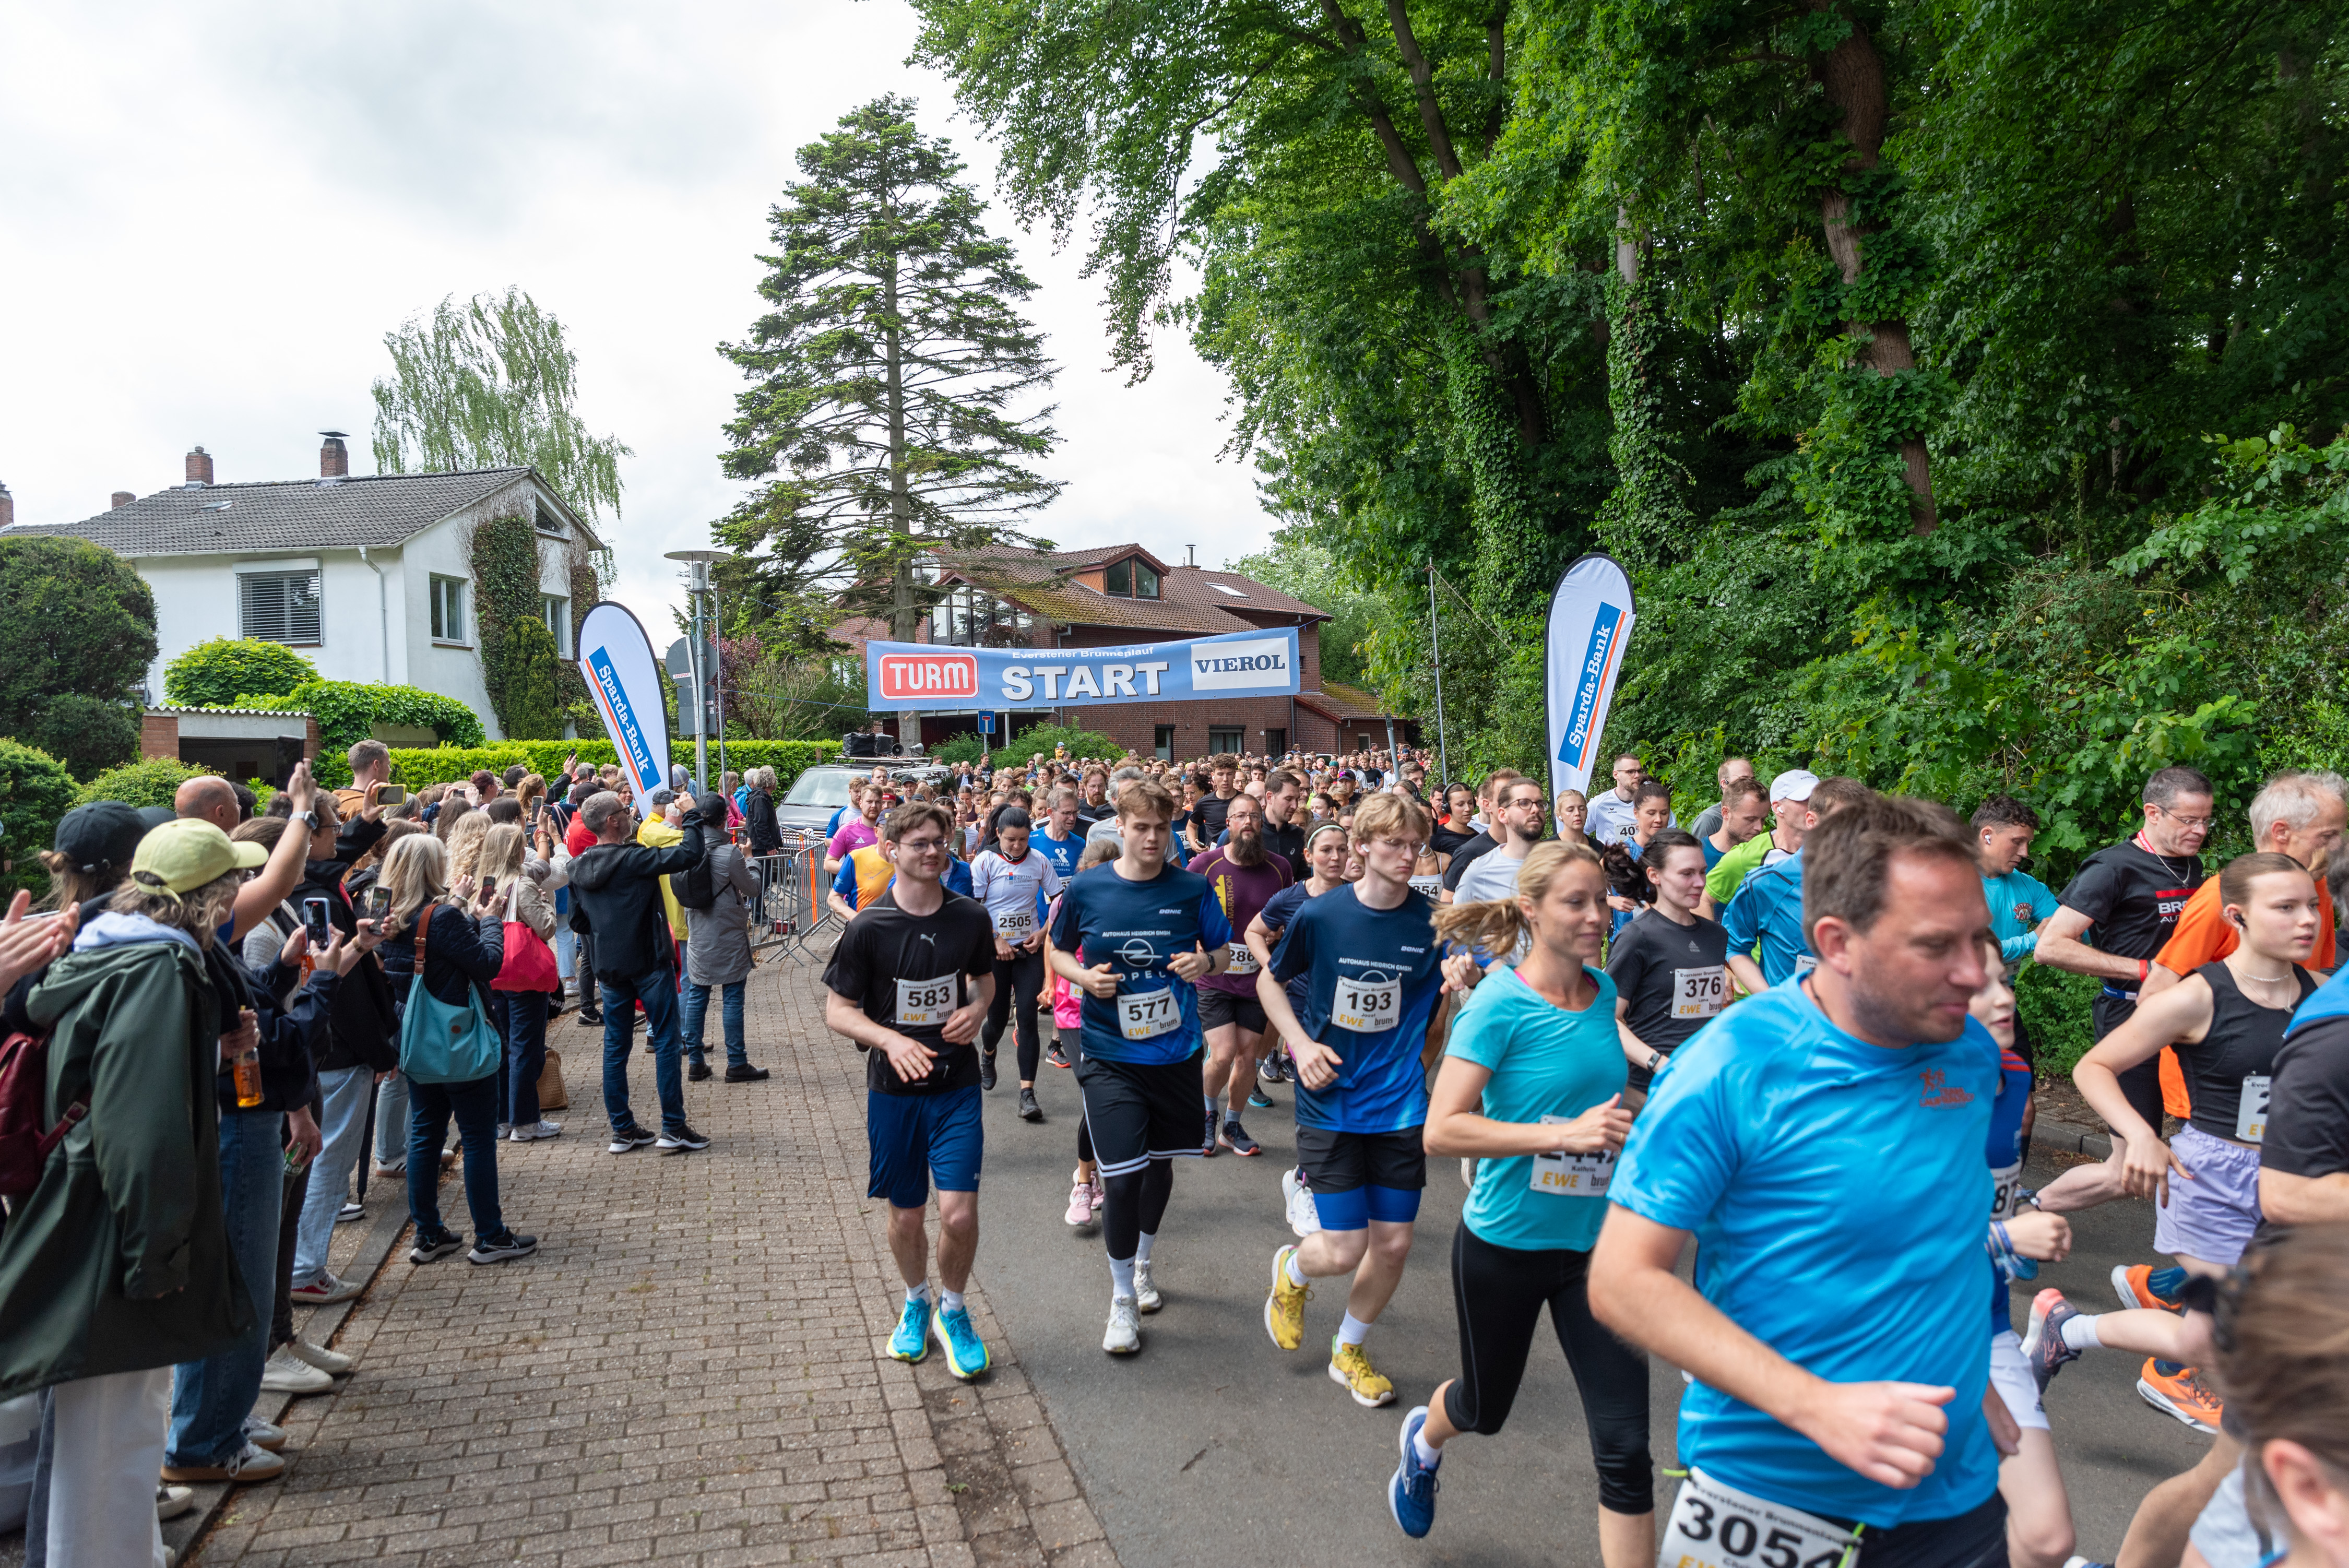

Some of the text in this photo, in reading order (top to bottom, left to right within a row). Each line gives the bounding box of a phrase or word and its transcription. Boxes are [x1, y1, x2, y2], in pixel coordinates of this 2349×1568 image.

[1081, 646, 1154, 658] Brunnenlauf
[1194, 655, 1285, 673] VIEROL
[889, 662, 969, 690] TURM
[1001, 661, 1169, 702] START
[1569, 624, 1611, 748] Sparda-Bank
[598, 664, 649, 774] Sparda-Bank
[1225, 875, 1235, 918] MARATHON
[999, 915, 1031, 928] 2505
[1338, 957, 1369, 966] AUTOHAUS
[1370, 961, 1395, 970] HEIDRICH
[1342, 982, 1370, 991] Everstener
[1684, 976, 1721, 997] 376
[907, 985, 950, 1007] 583
[1347, 991, 1392, 1012] 193
[903, 1013, 928, 1021] EWE
[1129, 996, 1170, 1021] 577
[1679, 1004, 1701, 1014] EWE
[1159, 1018, 1178, 1029] bruns
[1339, 1014, 1365, 1027] EWE
[1374, 1017, 1393, 1026] bruns
[1129, 1026, 1151, 1036] EWE
[1541, 1171, 1579, 1188] EWE
